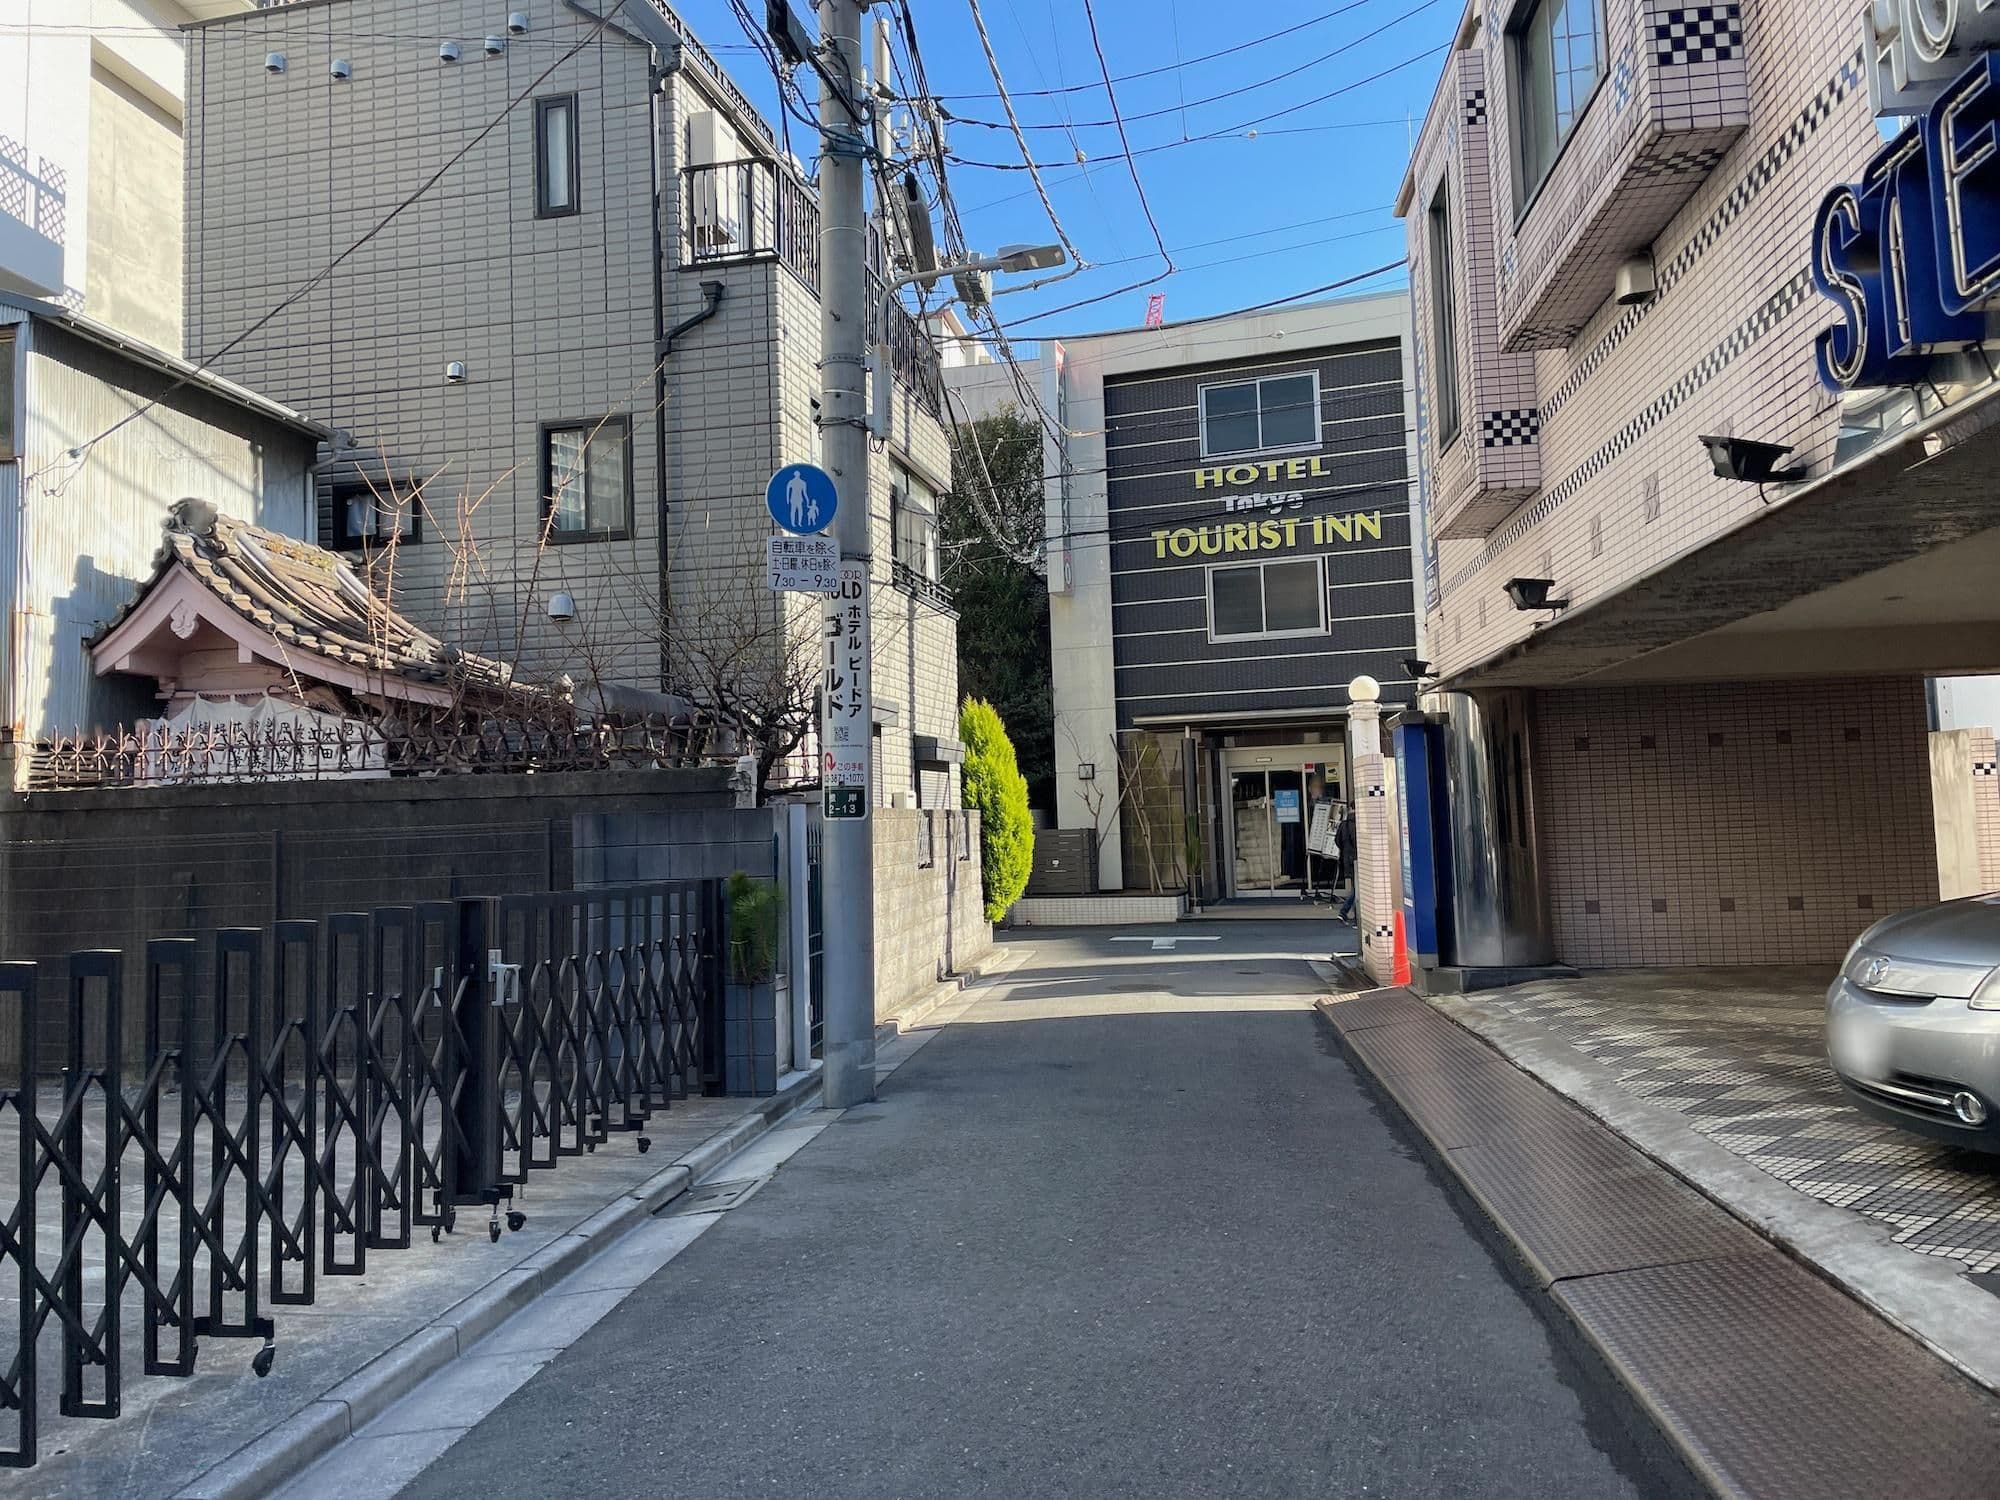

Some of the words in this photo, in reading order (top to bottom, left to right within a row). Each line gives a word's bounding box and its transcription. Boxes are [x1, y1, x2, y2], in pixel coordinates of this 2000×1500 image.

[1195, 456, 1331, 489] HOTEL
[771, 541, 836, 554] 自転車を除く
[1151, 517, 1300, 559] TOURIST
[1313, 510, 1382, 545] INN
[848, 604, 862, 650] ホテル
[825, 612, 844, 719] ゴールド
